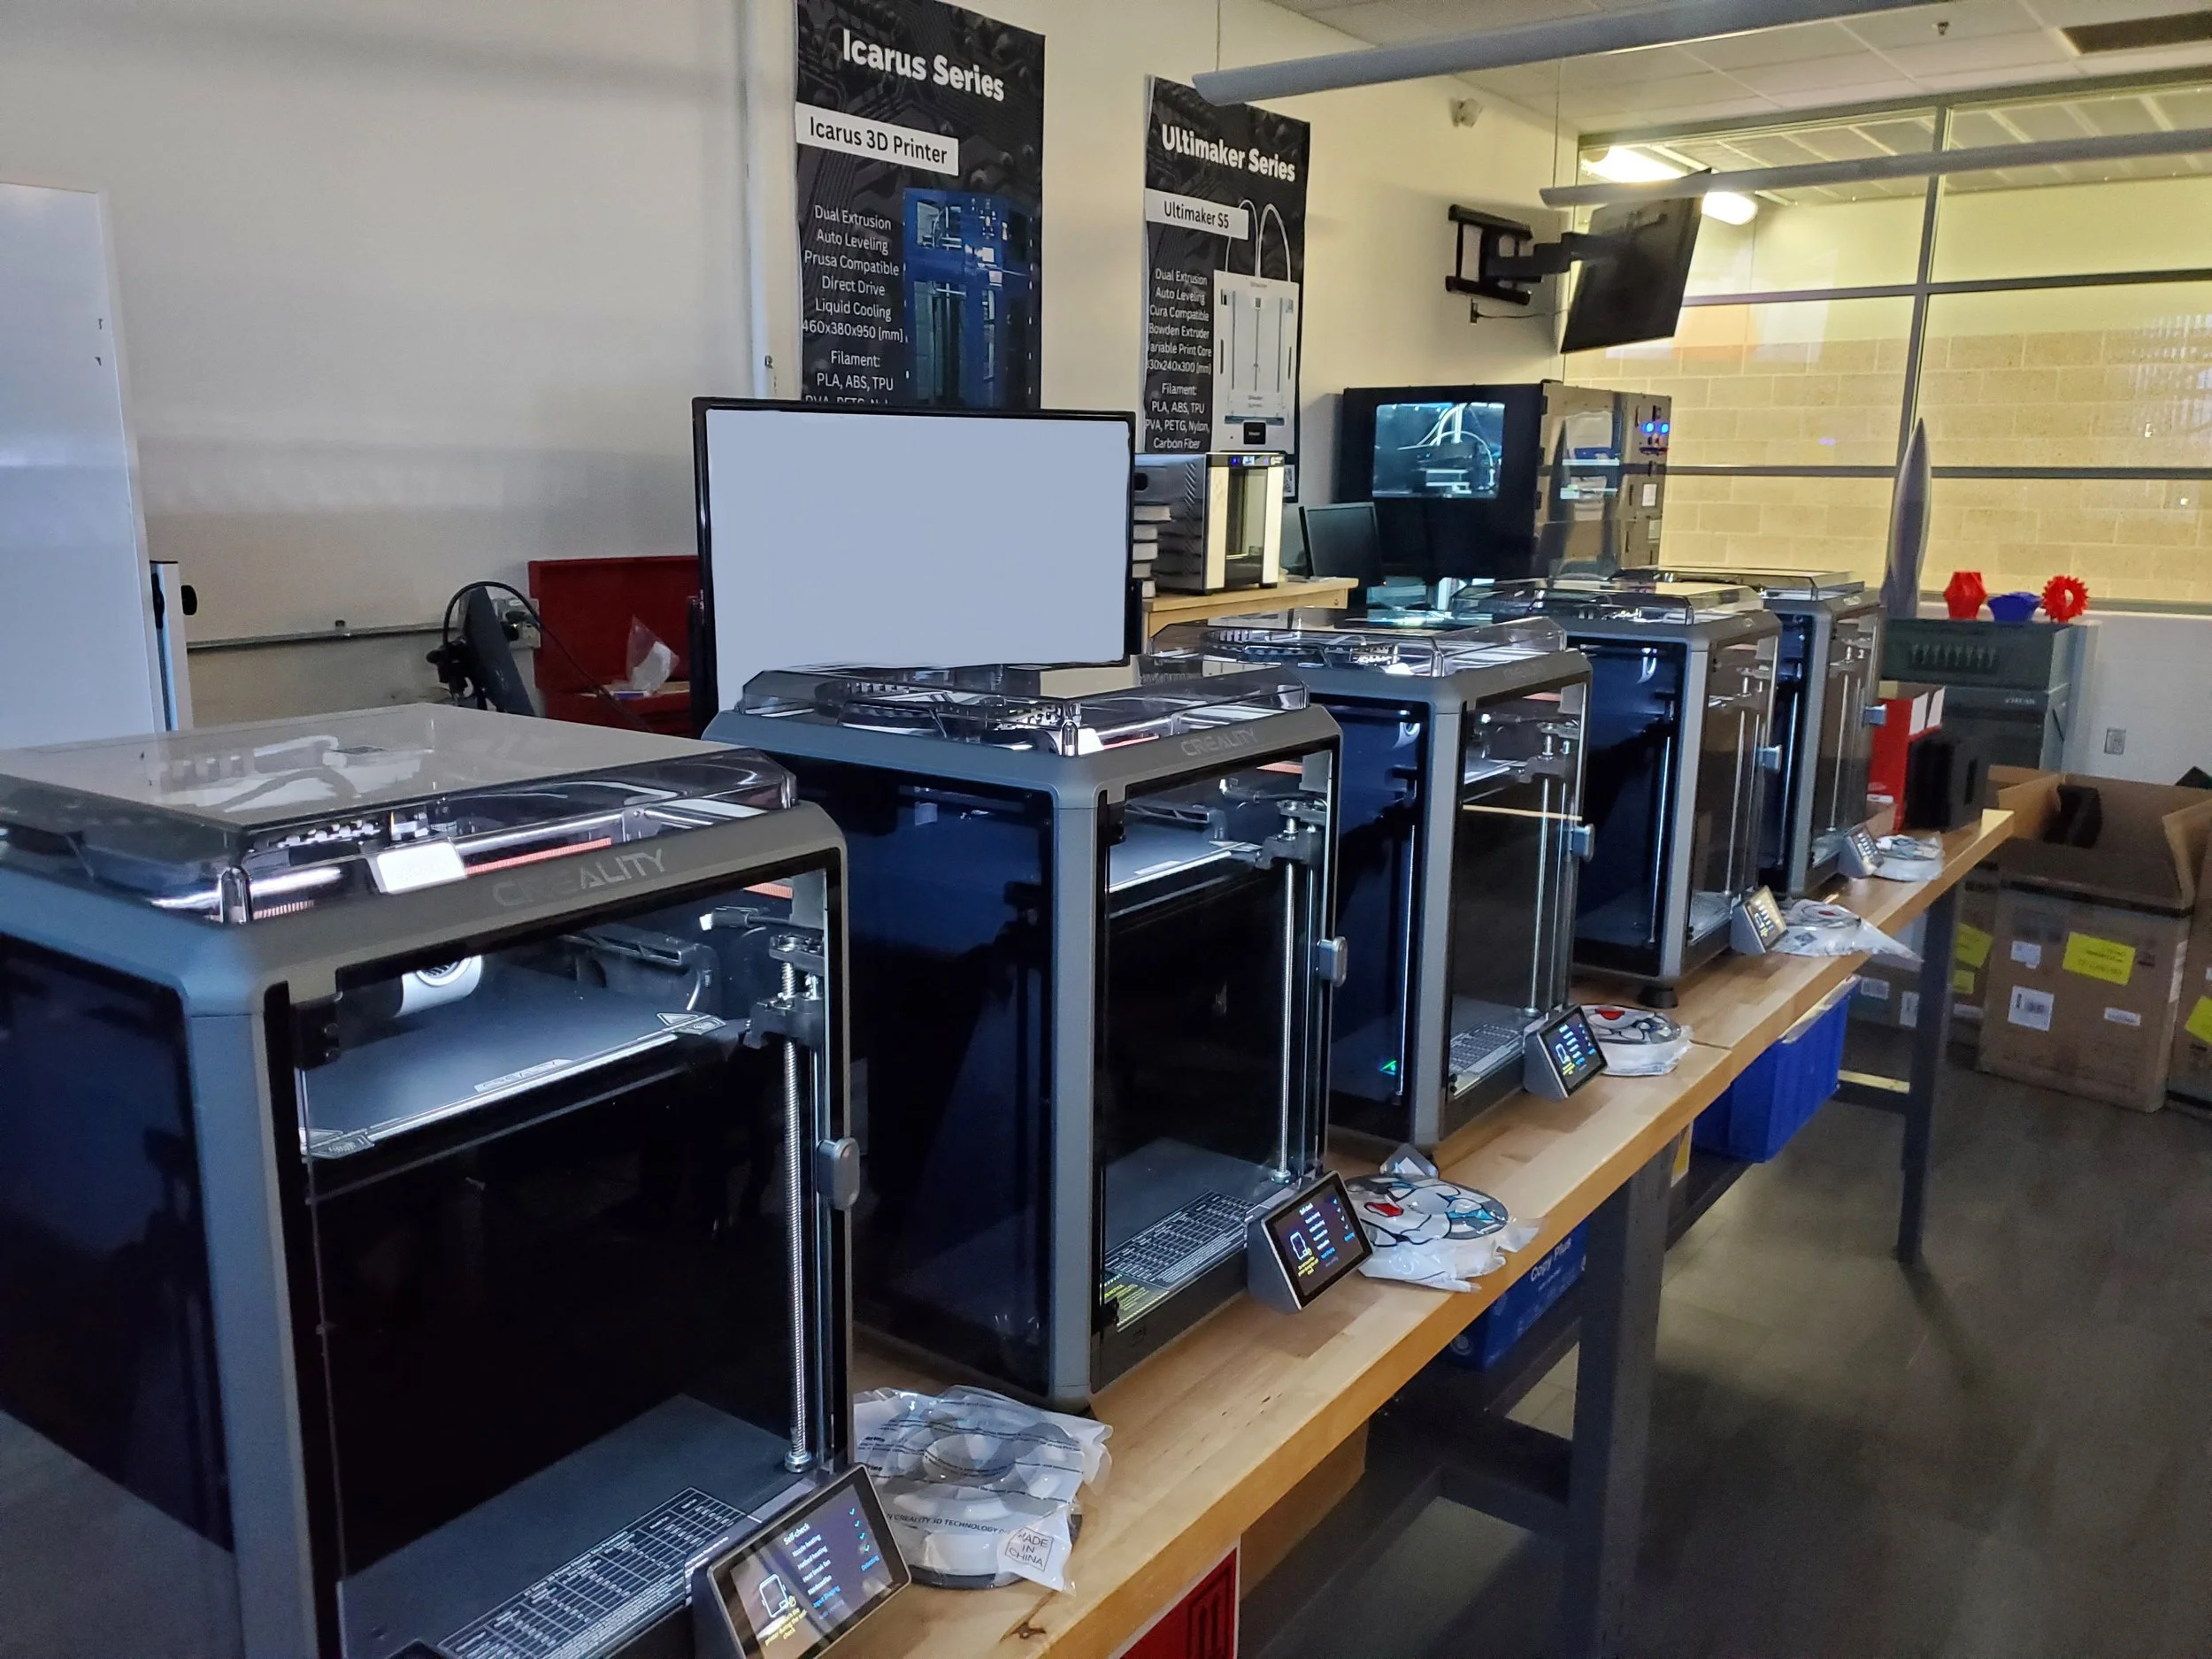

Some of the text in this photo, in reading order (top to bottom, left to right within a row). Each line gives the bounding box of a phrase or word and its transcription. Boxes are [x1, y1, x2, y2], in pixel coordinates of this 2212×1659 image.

[843, 28, 1005, 102] Icarus Series
[810, 116, 948, 165] Icarus 3D Printer
[1162, 124, 1295, 182] Ultimaker Series
[814, 204, 892, 231] Dual Extrusion
[1164, 201, 1230, 229] Ultimaker S5
[817, 228, 888, 256] Auto Leveling
[804, 250, 900, 276] Prusa Compatible
[822, 275, 886, 296] Direct Drive
[1155, 268, 1208, 286] Dual Extrusion
[1156, 287, 1205, 306] Auto Leveling
[815, 298, 892, 322] Liquid Cooling
[1149, 304, 1210, 322] Cura Compatible
[802, 319, 904, 343] 460x380x950 [mm]
[1148, 322, 1210, 339] Bowden Extruder
[831, 350, 881, 368] Filament:
[1149, 342, 1212, 357] ariable Print Core
[817, 373, 894, 392] PLA, ABS, TPU
[1151, 401, 1204, 415] PLA, ABS, TPU
[1145, 419, 1210, 434] PVA, PETG, Nylon,
[1153, 437, 1202, 449] Carbon Fiber
[1180, 727, 1257, 757] CREALITY
[1531, 1256, 1552, 1282] Copy
[894, 1514, 931, 1524] CREALITY
[944, 1519, 998, 1534] TECHNOLOGY
[783, 1523, 810, 1546] Self-check
[805, 1534, 821, 1548] heating
[812, 1546, 828, 1559] heating
[1009, 1548, 1044, 1568] CHINA
[1022, 1545, 1036, 1554] IN
